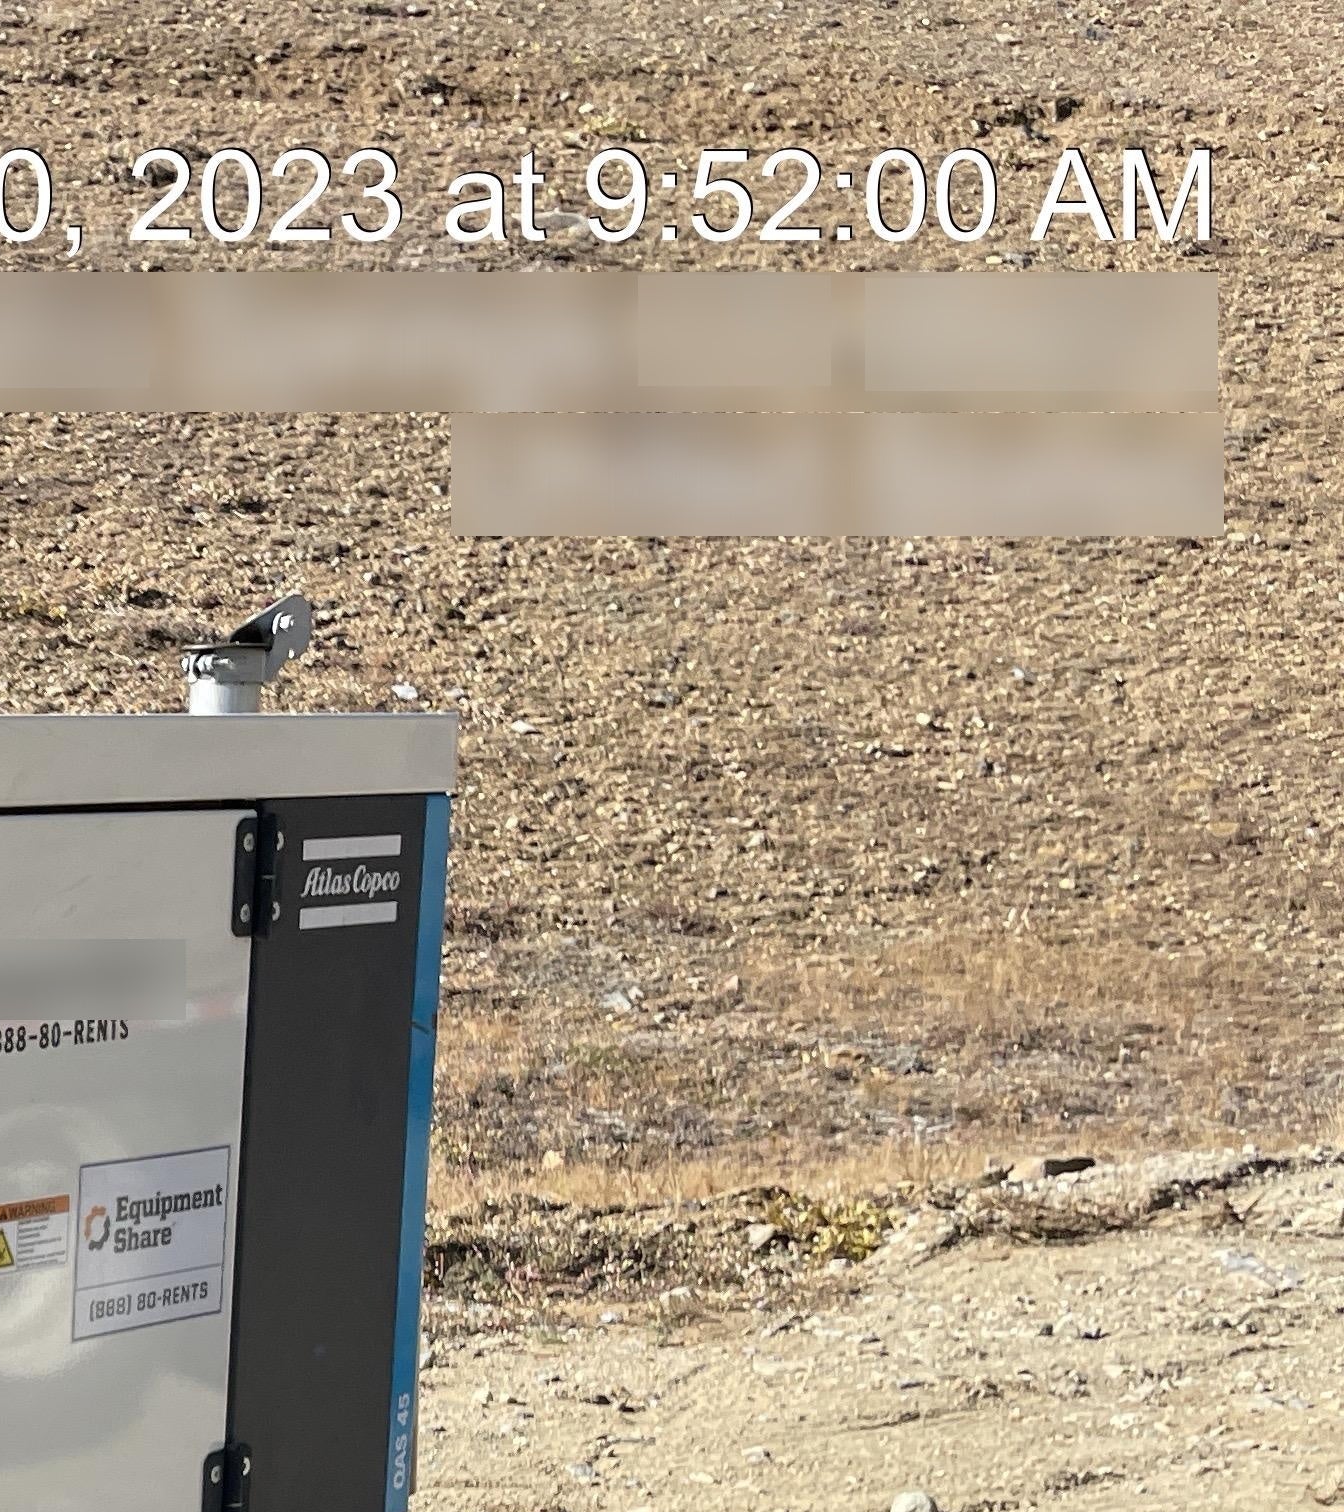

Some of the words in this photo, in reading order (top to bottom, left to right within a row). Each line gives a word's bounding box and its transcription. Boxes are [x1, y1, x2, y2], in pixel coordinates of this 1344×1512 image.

[300, 866, 352, 898] Atlas
[352, 865, 401, 899] Copco
[8, 1197, 56, 1220] WARNING
[115, 1183, 223, 1225] Equipment
[113, 1226, 173, 1254] Share
[137, 1281, 209, 1312] 80-RENTS
